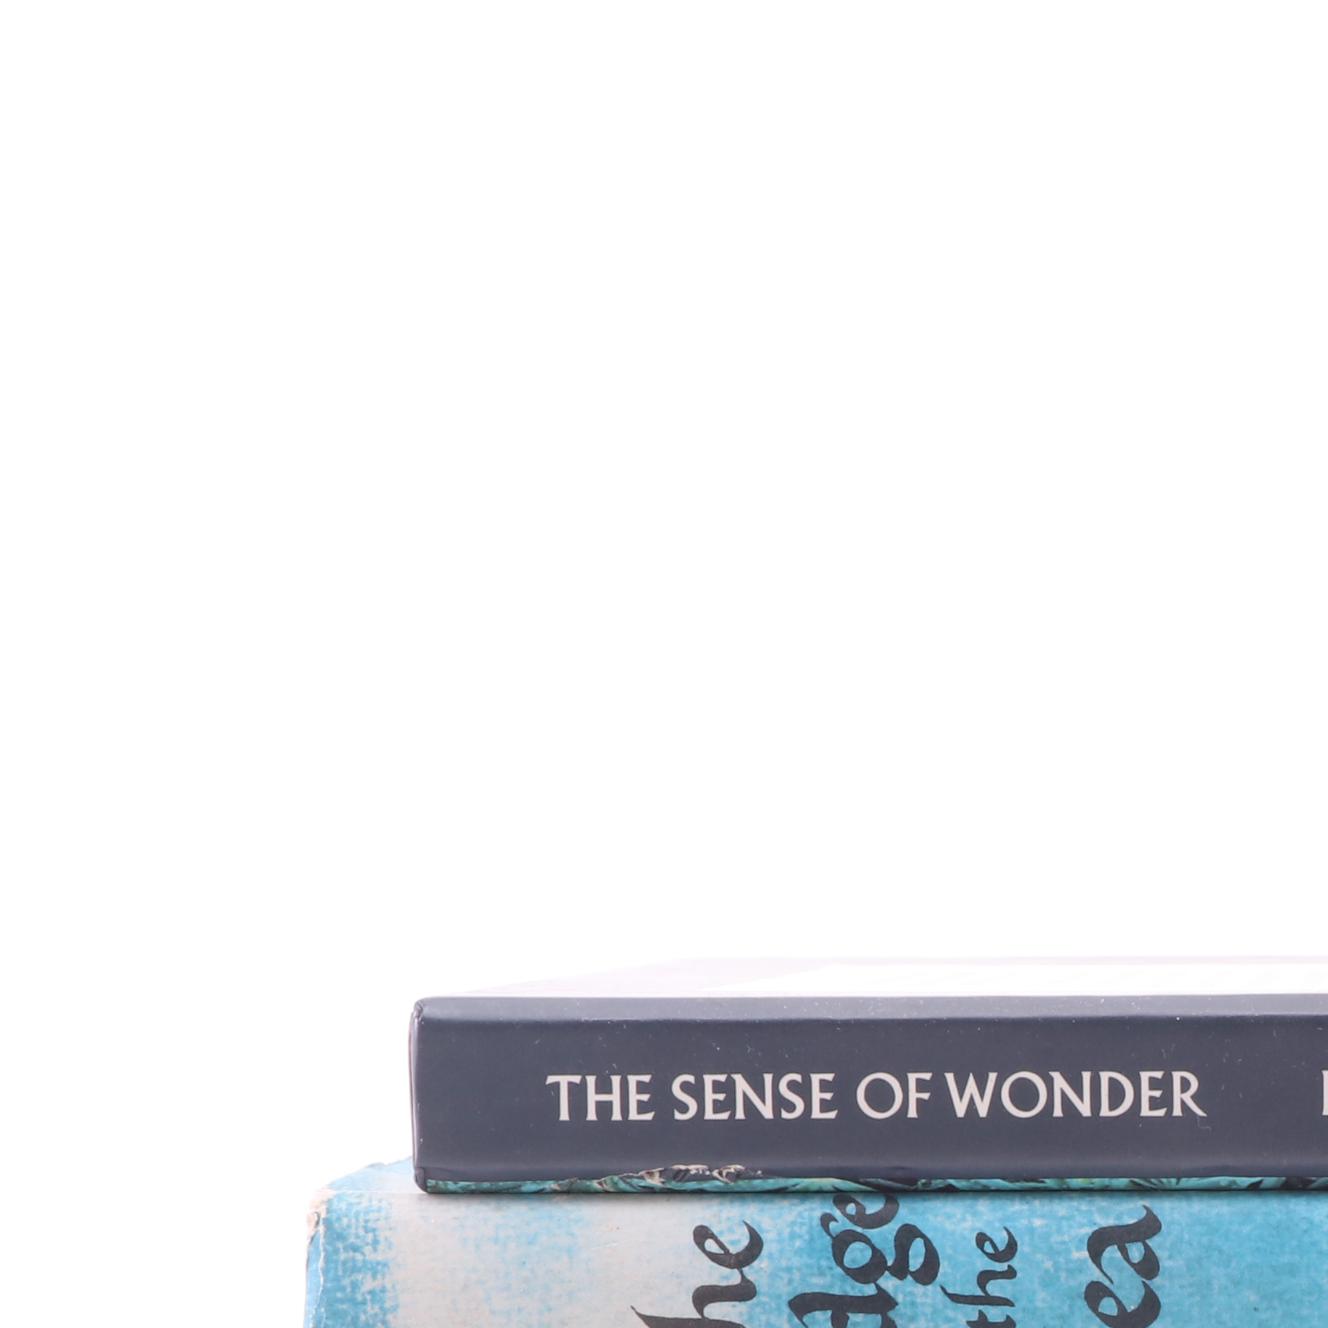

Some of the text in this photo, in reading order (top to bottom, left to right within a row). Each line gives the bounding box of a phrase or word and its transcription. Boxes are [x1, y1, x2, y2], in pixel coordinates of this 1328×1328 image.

[546, 1069, 1207, 1121] THE SENSE OF WONDER
